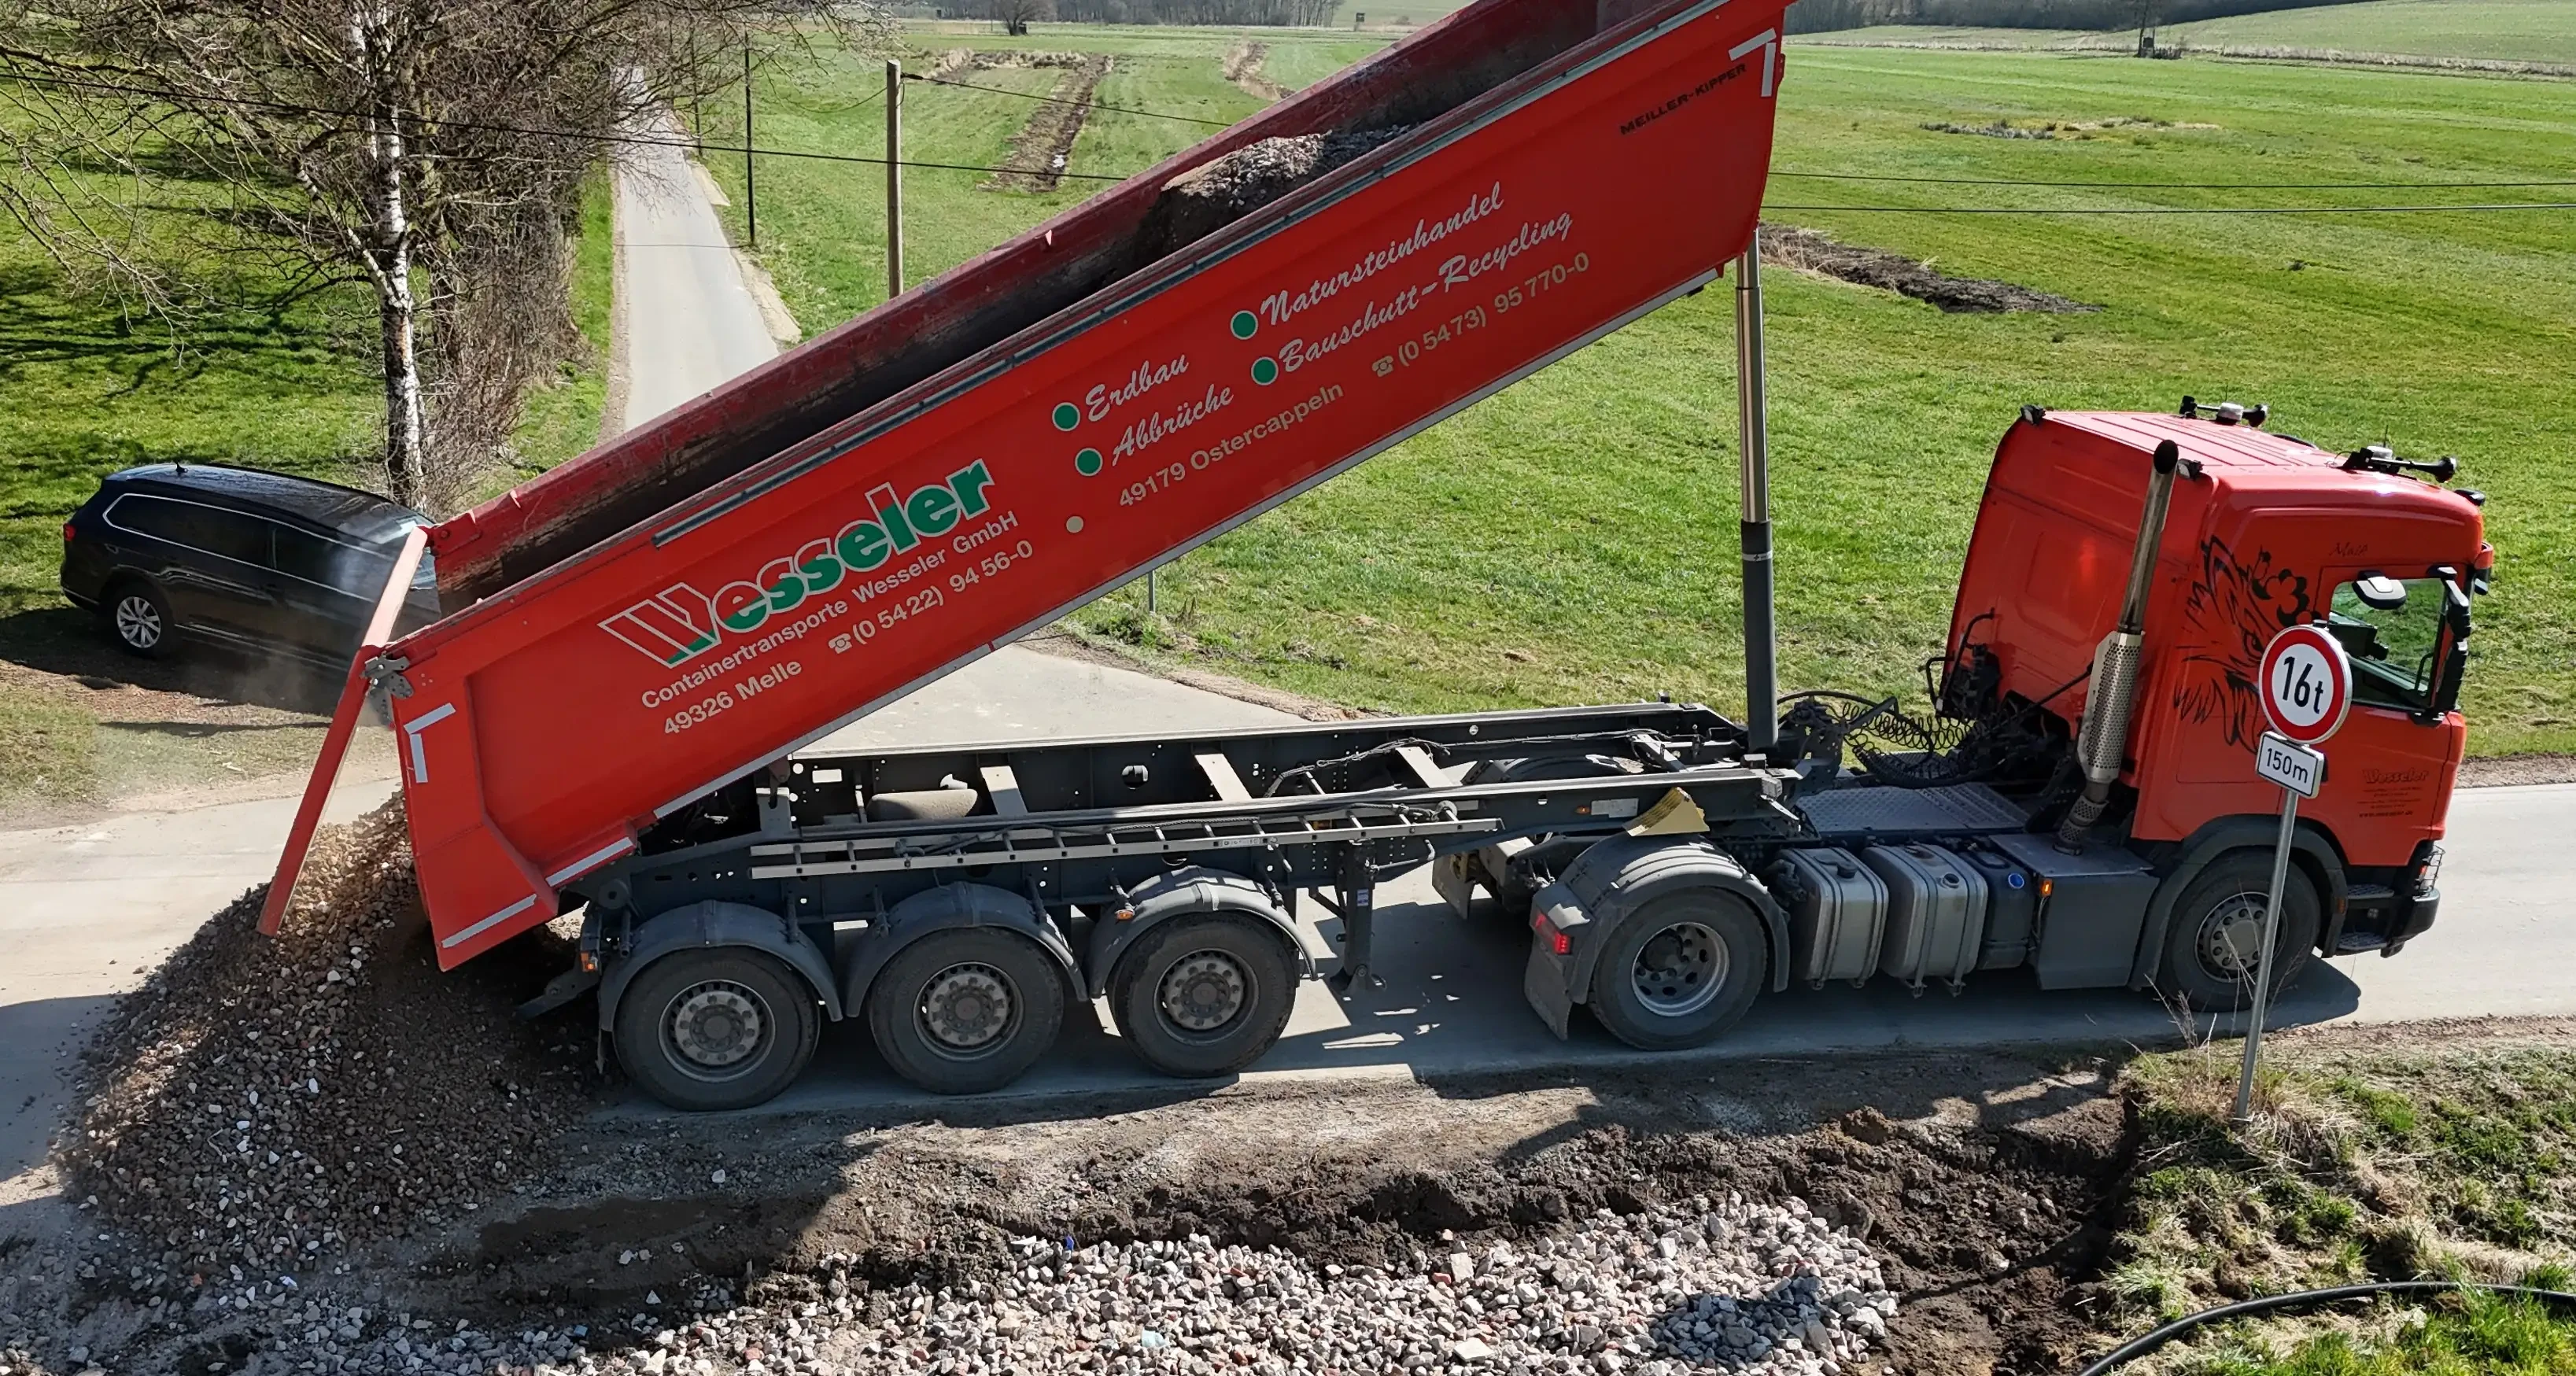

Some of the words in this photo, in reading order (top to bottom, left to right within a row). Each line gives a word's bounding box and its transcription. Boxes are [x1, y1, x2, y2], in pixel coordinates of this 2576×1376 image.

[1619, 63, 1747, 135] MEILLER-KIPPER
[1260, 182, 1503, 325] Natursteinhandel
[1279, 212, 1573, 372] Bauschutt-Recycling
[1526, 253, 1590, 300] 770-0
[1086, 355, 1189, 422] Erdbau
[1112, 384, 1232, 466] Abbrüche
[1119, 463, 1187, 506] 49179
[1191, 384, 1343, 470] Ostercappeln
[597, 459, 995, 668] Wesseler
[641, 599, 848, 708] Containertransporte
[853, 550, 947, 603] Wesseler
[953, 511, 1019, 555] GmbH
[664, 692, 733, 734] 49326
[736, 659, 801, 700] Melle
[2282, 656, 2325, 714] 16t
[2266, 747, 2308, 784] 150m
